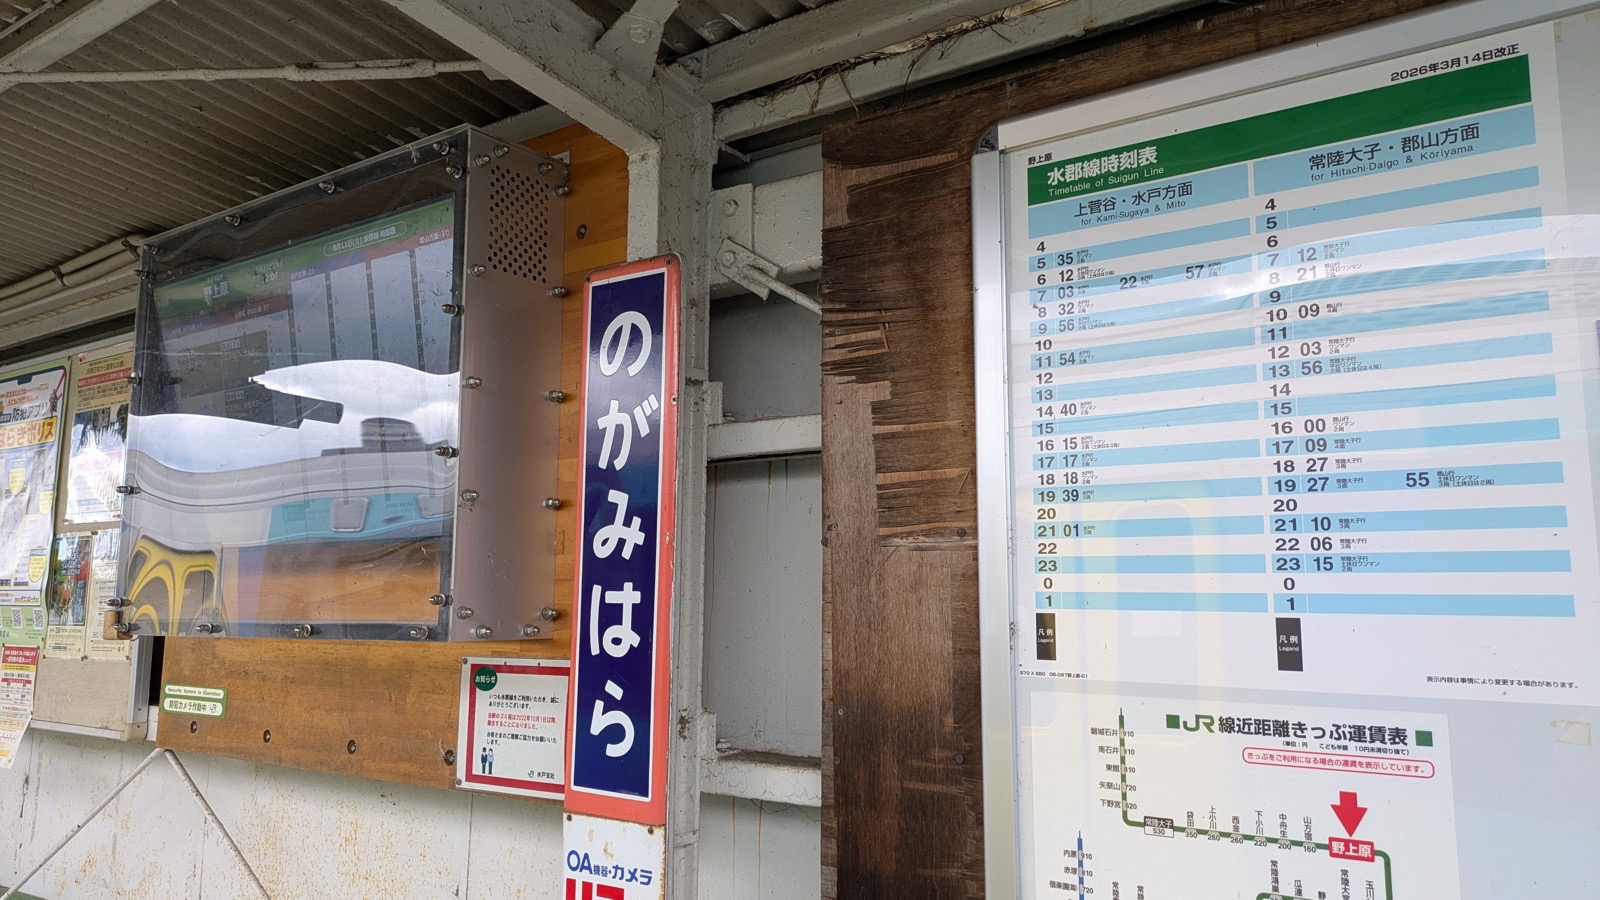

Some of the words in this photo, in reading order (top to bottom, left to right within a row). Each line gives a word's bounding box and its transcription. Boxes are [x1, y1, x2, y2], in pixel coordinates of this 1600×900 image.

[1390, 43, 1520, 82] 2026年3月14日改正
[1309, 122, 1480, 171] 常陸大子・郡山方面
[1028, 153, 1053, 165] 野上原
[1047, 146, 1158, 186] 水郡線時刻表
[1311, 172, 1325, 181] for
[1331, 159, 1399, 178] Hitachi-Daigo
[1405, 155, 1414, 164] &
[1048, 182, 1091, 197] Timetable
[1095, 177, 1104, 187] of
[1108, 171, 1139, 185] Suigun
[1144, 166, 1164, 177] Line
[1074, 181, 1193, 218] 上菅谷・水戸方面
[1265, 198, 1277, 211] 4
[1081, 218, 1092, 226] for
[1097, 207, 1150, 223] Kami-Sugaya
[1154, 203, 1161, 212] &
[1167, 200, 1186, 211] Mito
[1266, 216, 1277, 229] 5
[1036, 241, 1046, 252] 4
[1267, 235, 1278, 247] 6
[1037, 257, 1046, 269] 5
[1057, 252, 1074, 266] 35
[1267, 253, 1279, 266] 7
[1297, 247, 1317, 262] 12
[1037, 274, 1046, 285] 6
[1058, 269, 1074, 282] 12
[1269, 272, 1280, 284] 8
[1297, 266, 1317, 281] 21
[1037, 290, 1047, 301] 7
[1058, 285, 1074, 299] 03
[1120, 275, 1137, 290] 22
[1185, 264, 1204, 280] 57
[1269, 291, 1281, 303] 9
[1038, 307, 1047, 318] 8
[1058, 302, 1075, 316] 32
[1266, 308, 1287, 322] 10
[1298, 303, 1320, 318] 09
[1038, 323, 1047, 334] 9
[1058, 319, 1075, 332] 56
[1267, 326, 1287, 340] 11
[1035, 339, 1052, 351] 10
[1268, 346, 1290, 359] 12
[1300, 341, 1322, 356] 03
[1036, 355, 1052, 368] 11
[1059, 352, 1076, 366] 54
[1268, 364, 1290, 378] 13
[1301, 360, 1323, 376] 56
[1036, 372, 1053, 384] 12
[1036, 389, 1053, 401] 13
[1269, 383, 1291, 397] 14
[1036, 406, 1054, 418] 14
[1060, 403, 1077, 416] 40
[1270, 402, 1292, 416] 15
[1037, 422, 1054, 435] 15
[1271, 421, 1293, 435] 16
[1304, 418, 1326, 433] 00
[1037, 439, 1054, 452] 16
[1062, 437, 1077, 450] 15
[1272, 440, 1294, 454] 17
[1305, 438, 1327, 453] 09
[1037, 456, 1055, 469] 17
[1062, 454, 1078, 468] 17
[1273, 460, 1295, 473] 18
[1306, 457, 1328, 472] 27
[1038, 473, 1055, 485] 18
[1063, 471, 1078, 485] 18
[1274, 479, 1296, 493] 19
[1307, 477, 1329, 492] 27
[1406, 472, 1430, 488] 55
[1038, 490, 1056, 502] 19
[1062, 489, 1079, 502] 39
[1273, 499, 1298, 512] 20
[1037, 508, 1056, 520] 20
[1038, 525, 1056, 537] 21
[1063, 523, 1079, 537] 01
[1274, 518, 1297, 531] 21
[1311, 516, 1331, 531] 10
[589, 310, 659, 759] のがみはら
[1037, 542, 1057, 555] 22
[1275, 538, 1300, 551] 22
[1310, 536, 1333, 551] 06
[1038, 559, 1058, 572] 23
[1276, 557, 1301, 571] 23
[1313, 556, 1334, 571] 15
[1043, 577, 1053, 589] 0
[1283, 577, 1295, 590] 0
[1045, 595, 1052, 607] 1
[1286, 597, 1295, 611] 1
[1279, 635, 1298, 644] 凡例
[475, 675, 496, 684] お知らせ
[1426, 675, 1579, 689] 表示内容は事情により変更する場合があります。
[1247, 752, 1425, 774] きっぷをご利用になる場合の運賃を表示しています。
[1230, 836, 1244, 844] 260
[1254, 839, 1267, 847] 220
[1278, 842, 1292, 850] 200
[1080, 852, 1093, 860] 910
[1303, 845, 1317, 853] 160
[1331, 841, 1372, 858] 野上原
[567, 850, 653, 886] OA機器・カメラ
[1081, 869, 1093, 877] 810
